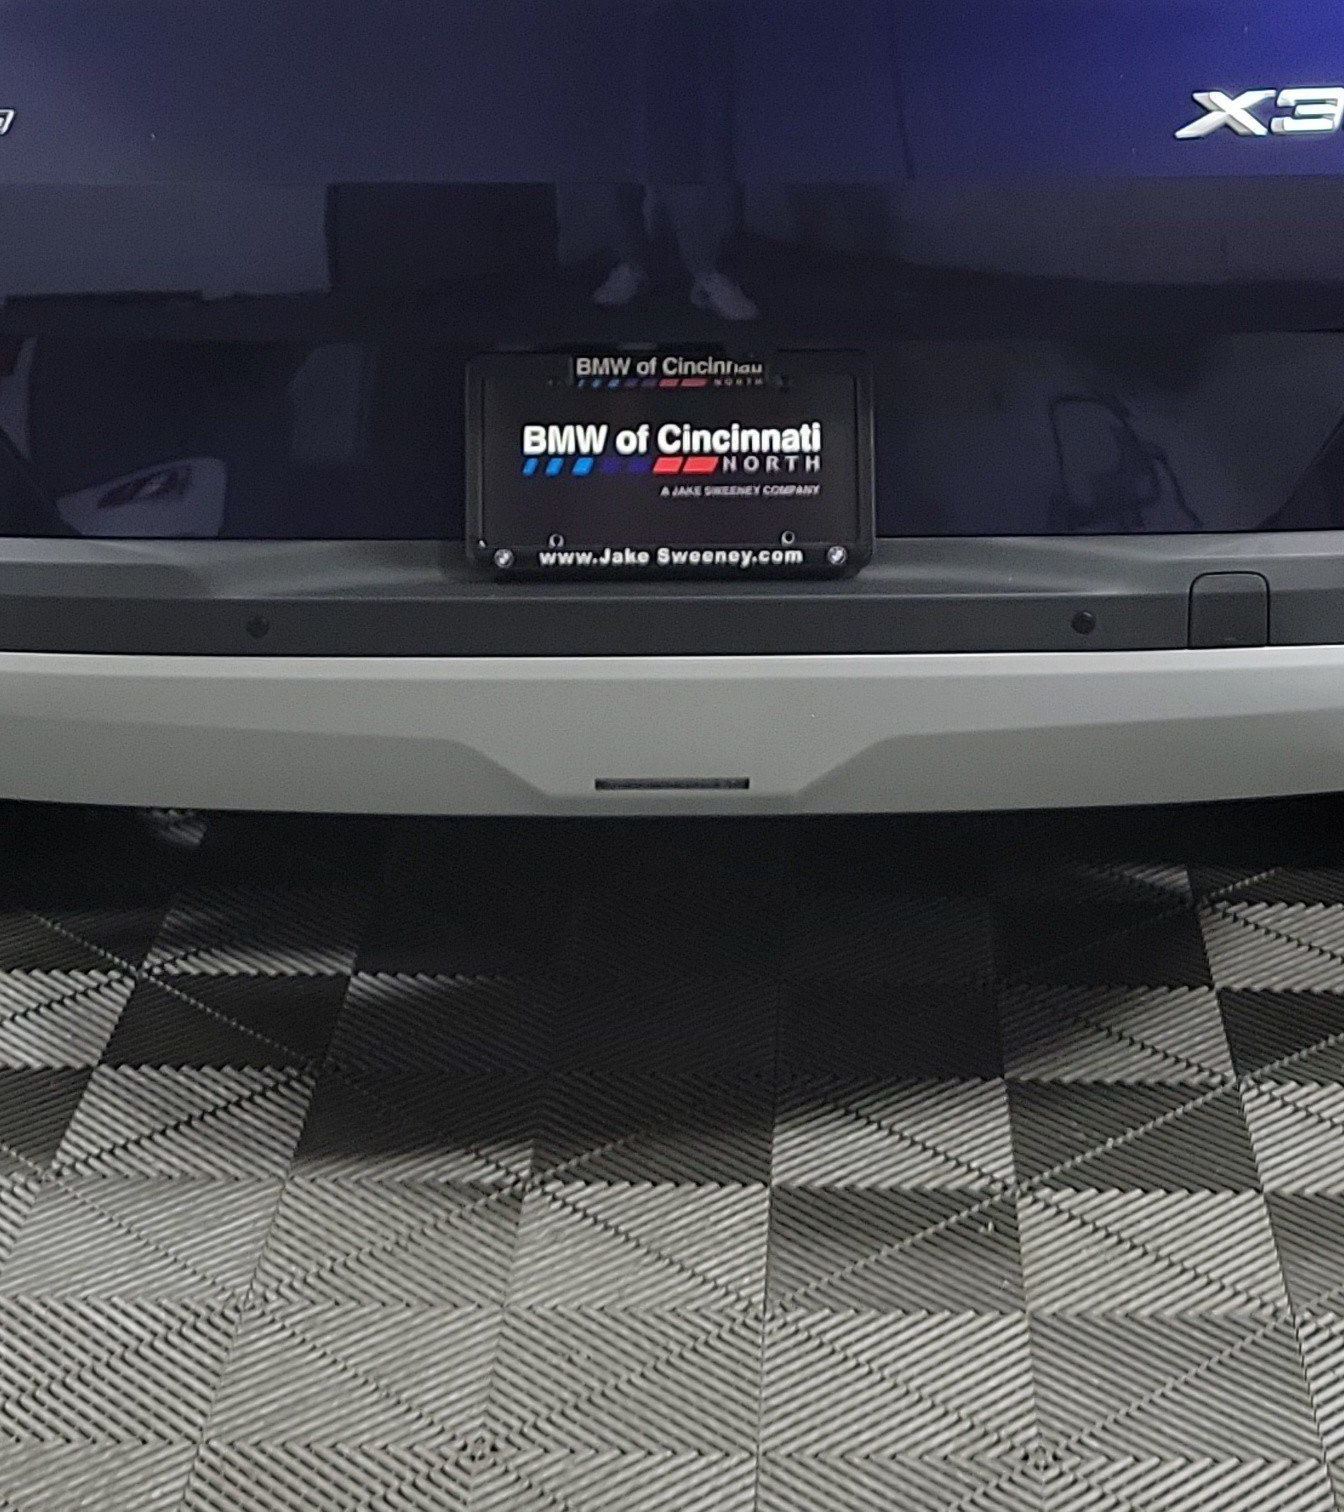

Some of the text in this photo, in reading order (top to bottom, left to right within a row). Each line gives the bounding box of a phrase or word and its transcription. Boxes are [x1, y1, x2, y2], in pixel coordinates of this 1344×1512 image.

[576, 357, 631, 376] BMW
[636, 356, 657, 376] of
[523, 422, 822, 454] BMW of Cincinnati
[722, 455, 821, 473] NORTH
[660, 485, 821, 496] A JAKE SWEENEY COMPANY
[540, 547, 804, 569] www.Jake Sweeney.com
